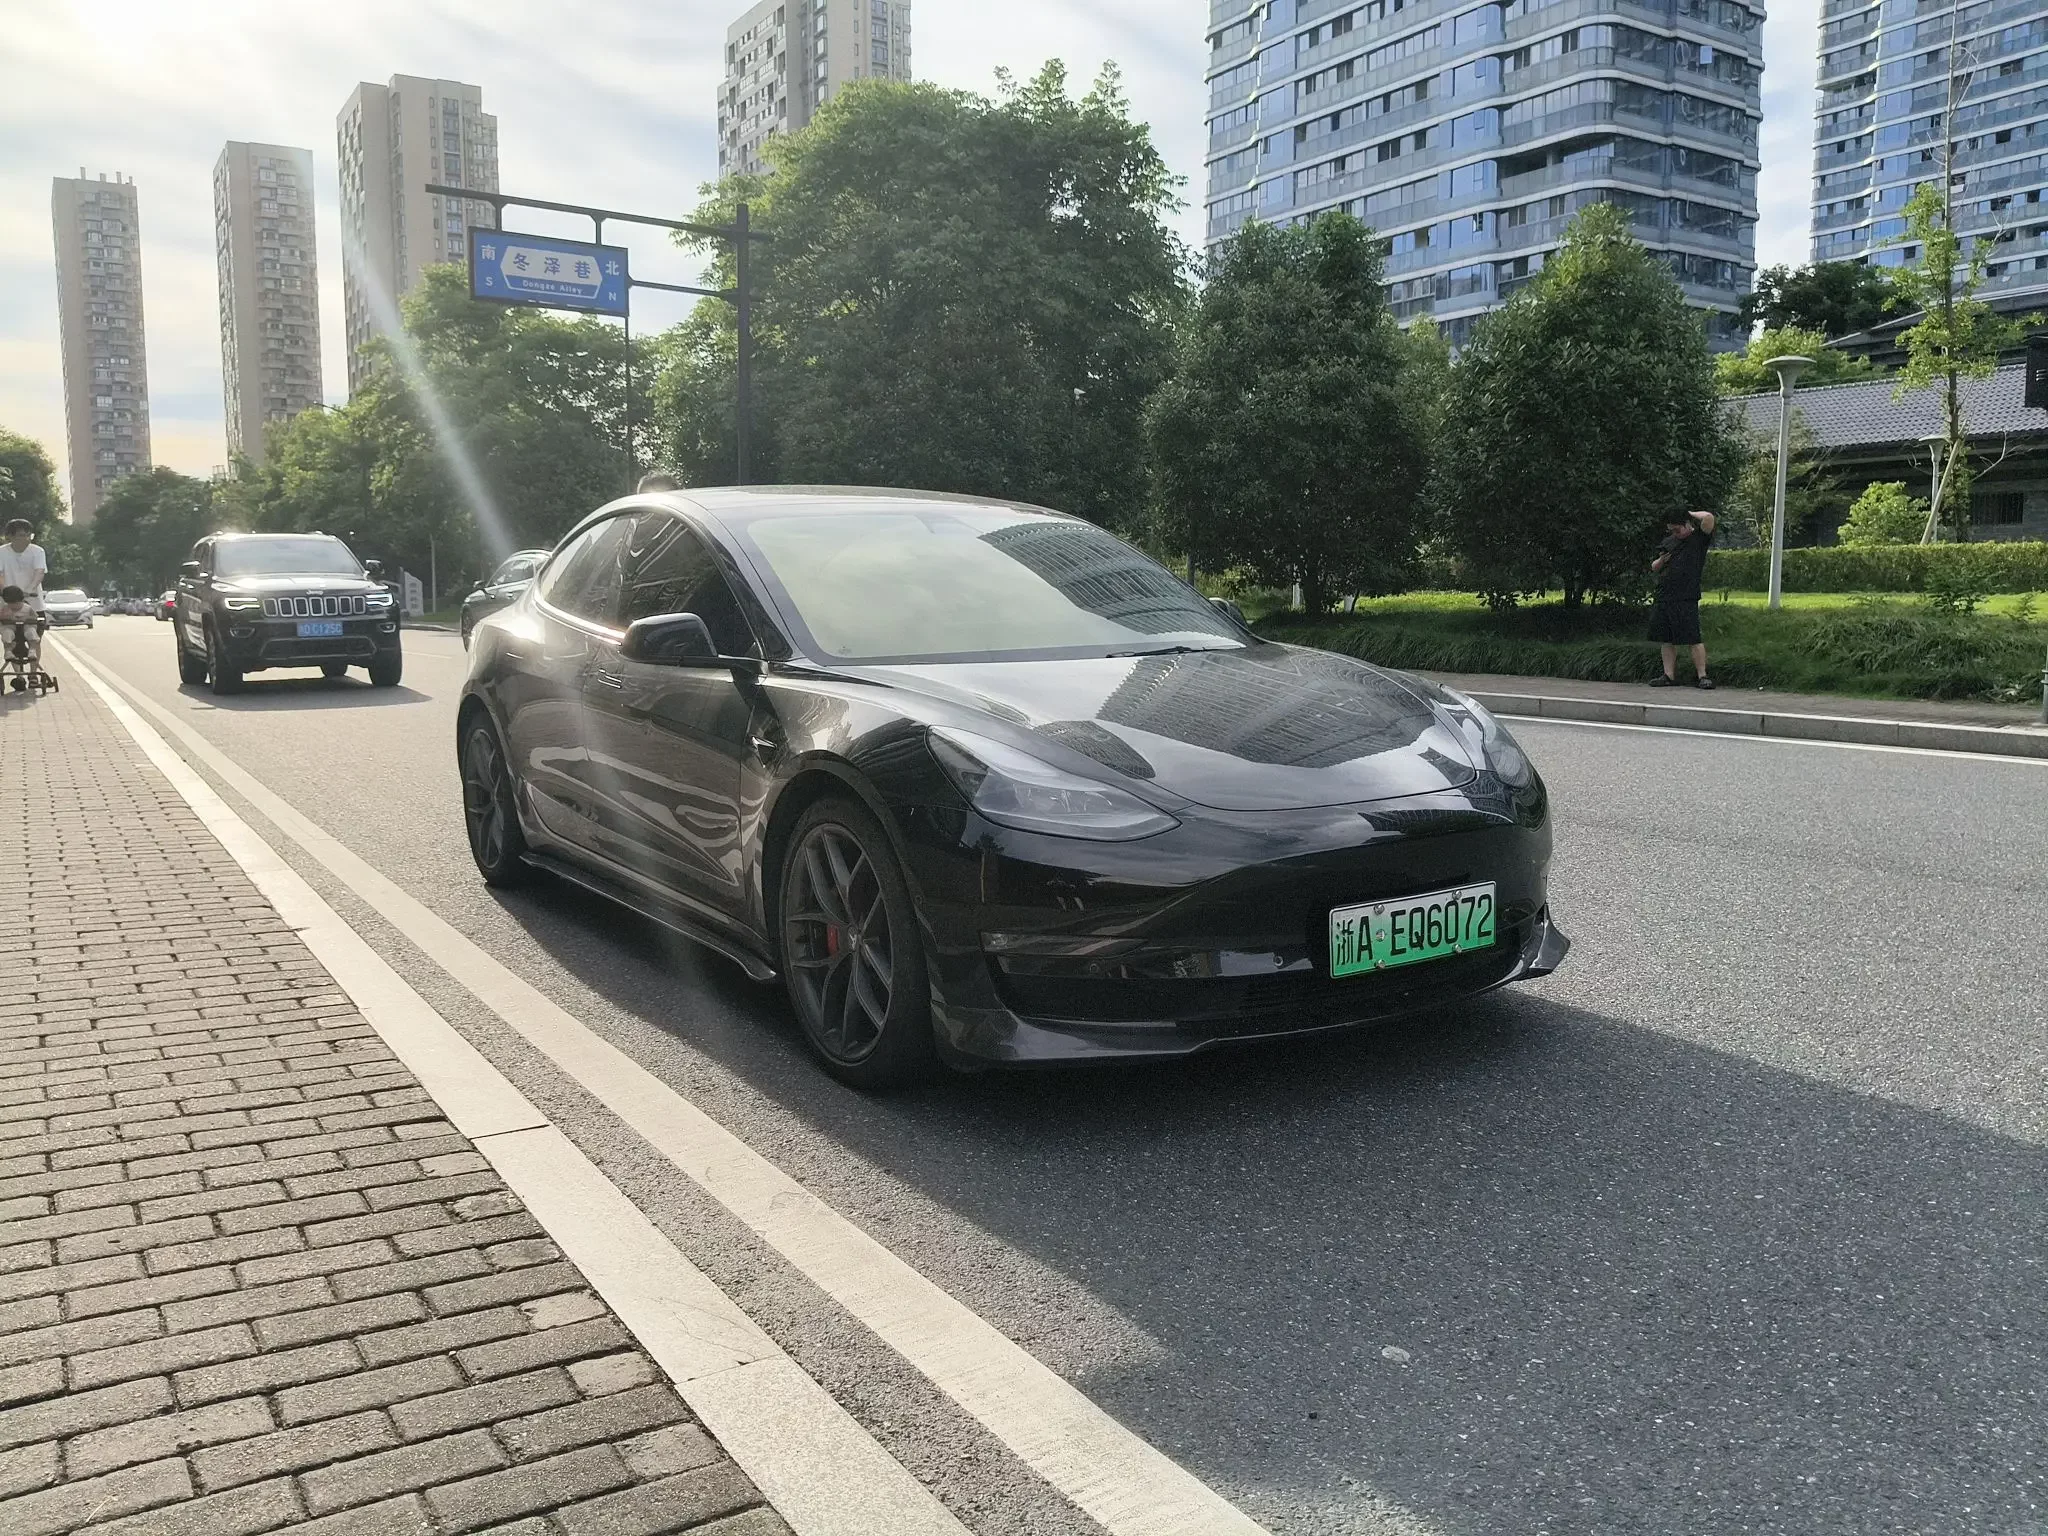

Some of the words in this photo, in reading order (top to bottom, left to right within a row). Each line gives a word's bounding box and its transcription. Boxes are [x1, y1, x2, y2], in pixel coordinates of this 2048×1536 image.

[481, 244, 496, 261] 南
[513, 253, 591, 279] 冬泽巷
[605, 260, 620, 276] 北
[485, 276, 493, 287] S
[522, 279, 556, 291] Dongze
[560, 283, 583, 295] Alley
[608, 291, 617, 301] N
